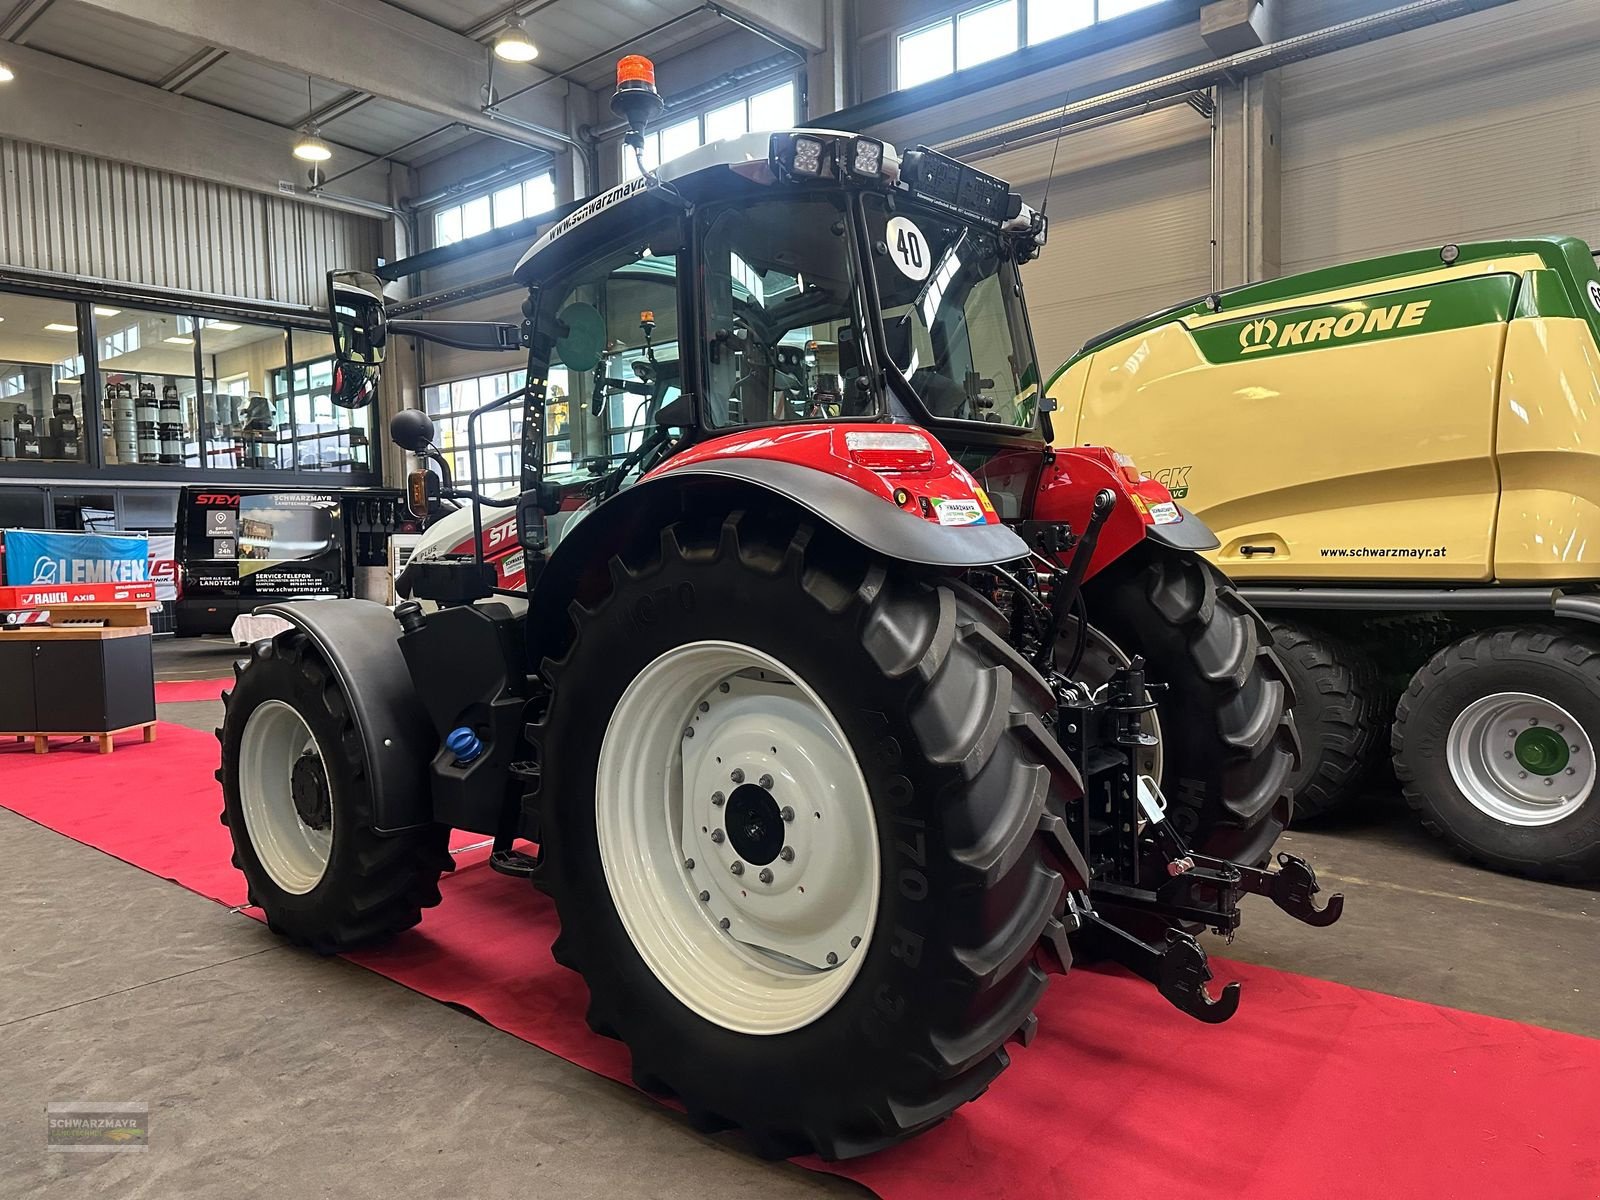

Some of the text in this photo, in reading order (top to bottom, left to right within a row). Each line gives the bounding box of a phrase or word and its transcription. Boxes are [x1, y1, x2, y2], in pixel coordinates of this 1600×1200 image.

[549, 177, 646, 241] www.schwarzmayr.
[896, 228, 923, 268] 40
[1276, 300, 1432, 348] KRONE
[490, 519, 517, 547] STE
[420, 545, 437, 559] PLUS
[1320, 546, 1447, 559] www.schwarzmayr.at
[60, 559, 145, 584] LEMKEN
[34, 591, 95, 604] RAUCH AXIS
